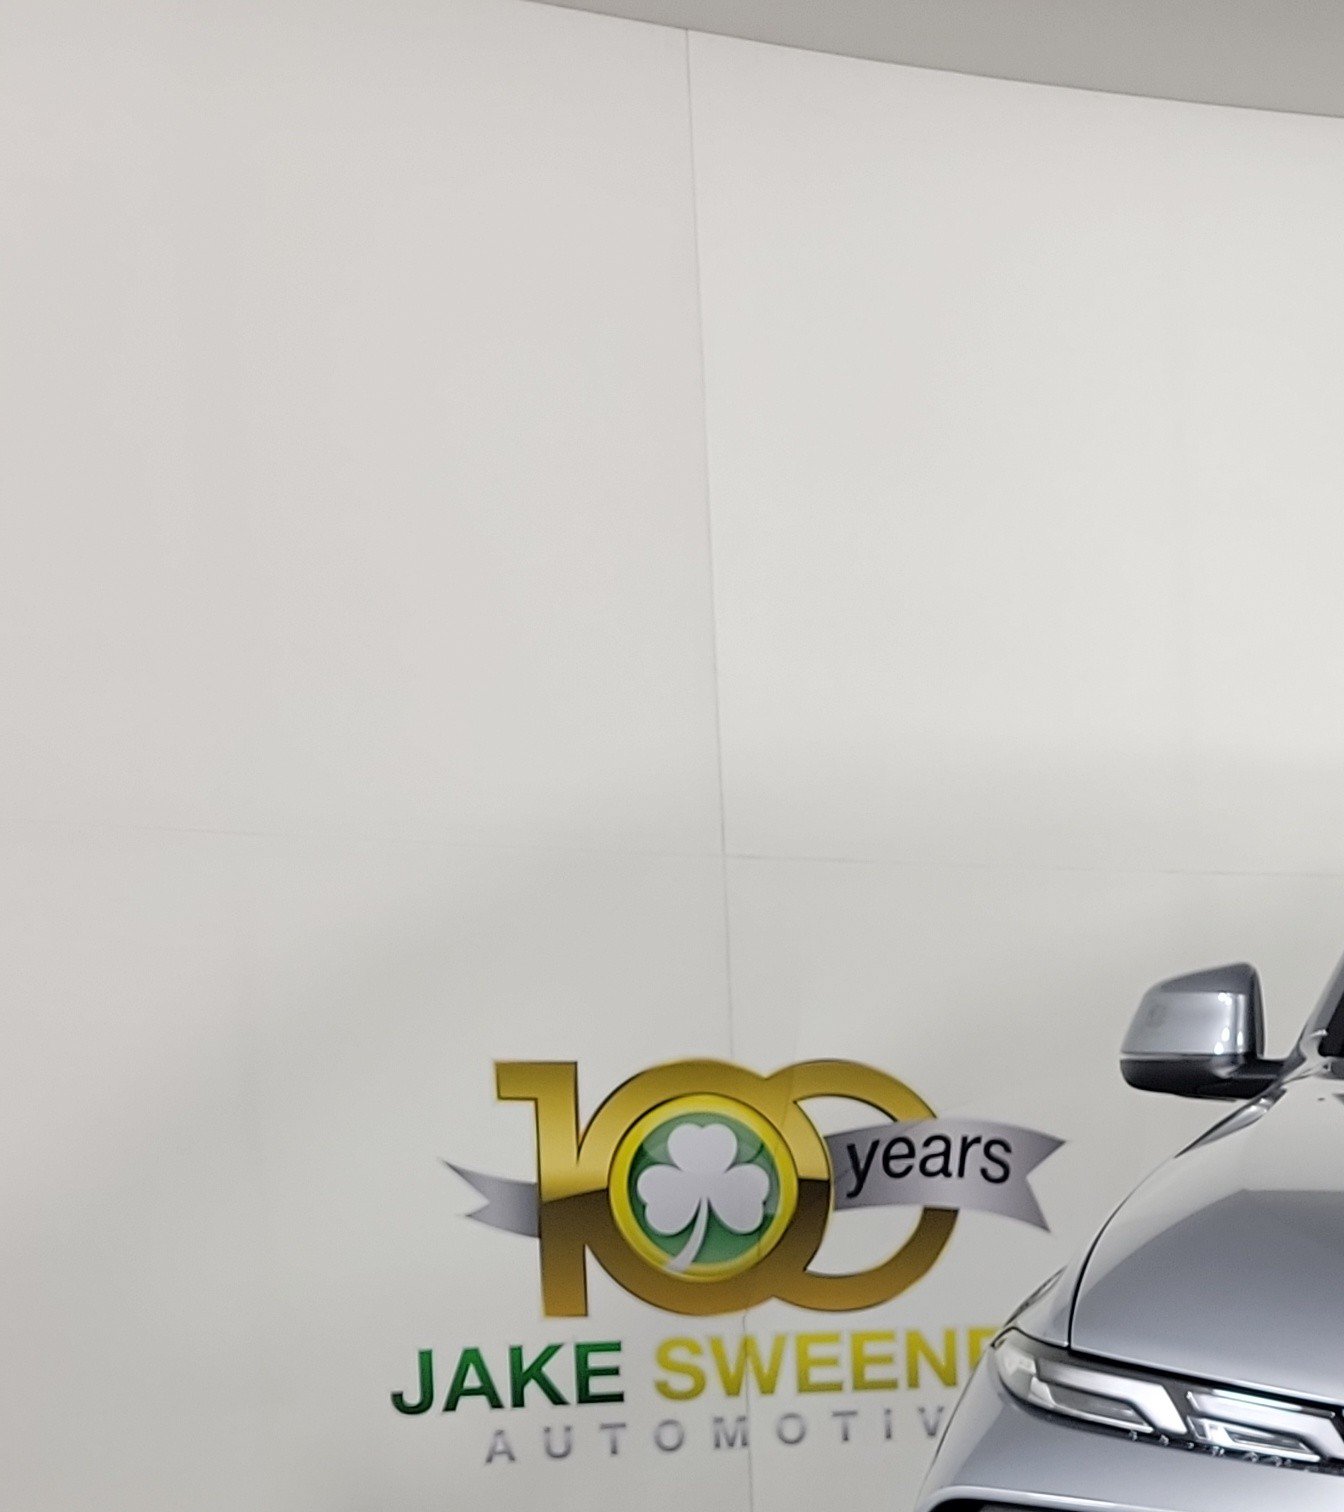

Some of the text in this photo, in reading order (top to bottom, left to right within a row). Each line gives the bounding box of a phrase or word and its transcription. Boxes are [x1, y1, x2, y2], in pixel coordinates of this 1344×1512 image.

[493, 1057, 1014, 1319] 100 years
[391, 1341, 625, 1416] JAKE
